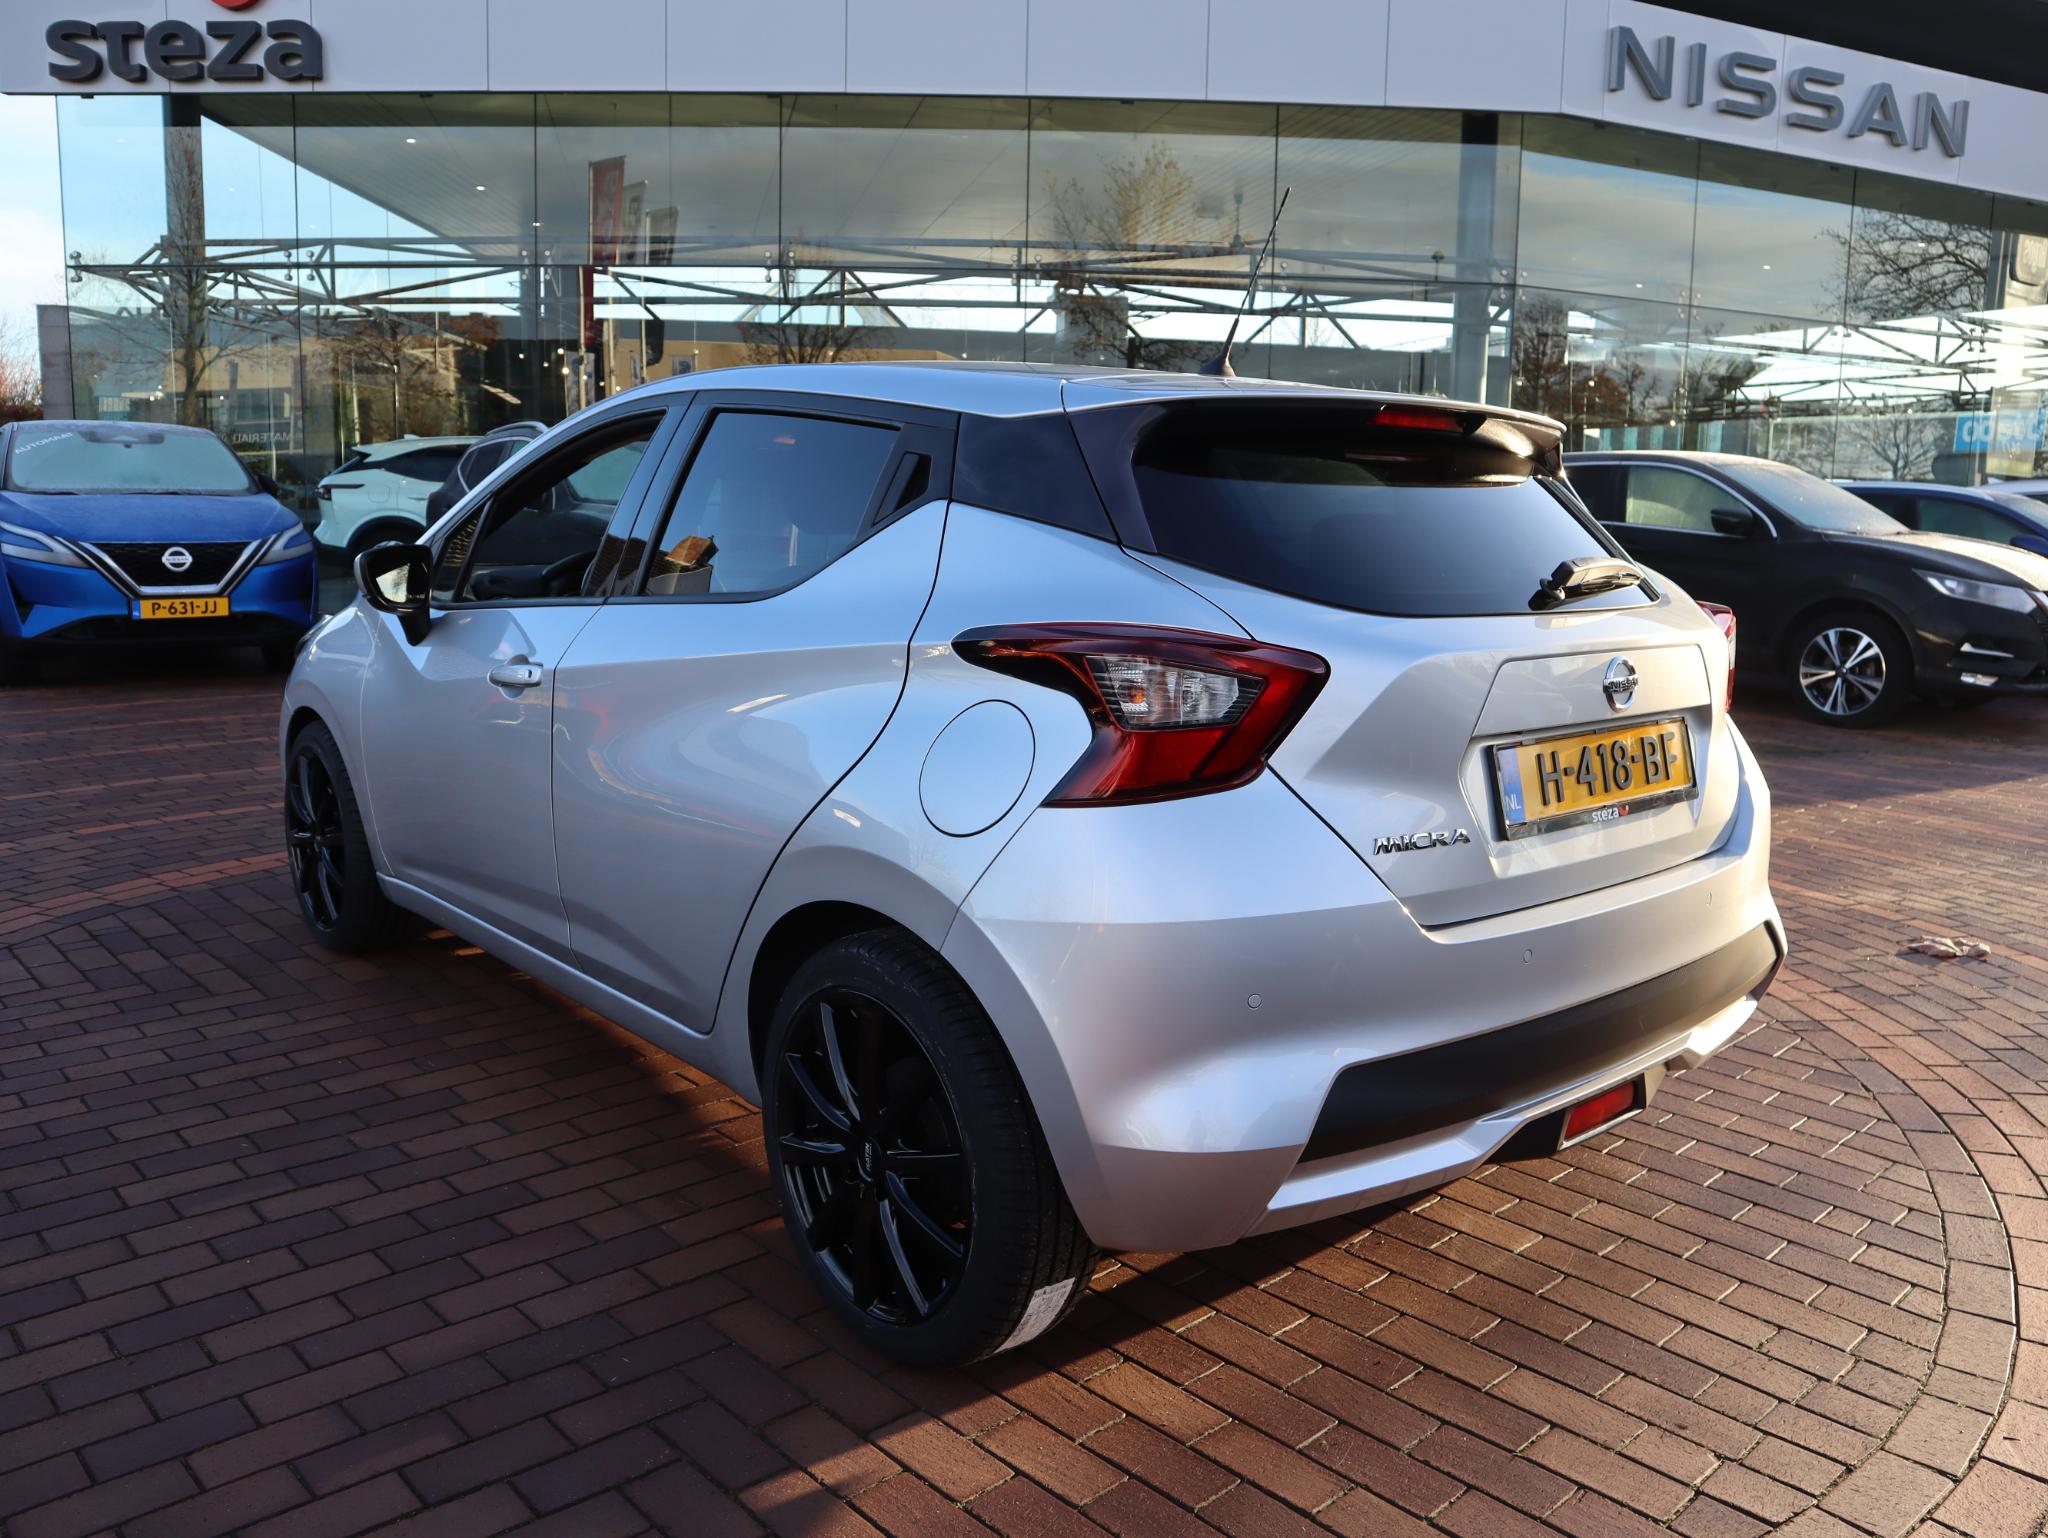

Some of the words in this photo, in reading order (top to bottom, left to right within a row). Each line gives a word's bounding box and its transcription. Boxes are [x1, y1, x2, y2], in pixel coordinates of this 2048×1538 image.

[45, 18, 323, 83] steza
[1608, 25, 1970, 158] NISSAN
[151, 599, 218, 617] P-631-JJ
[1536, 730, 1677, 806] H-418-BF
[1505, 792, 1522, 811] NL
[1591, 806, 1620, 823] steza
[1373, 828, 1472, 856] MICRA
